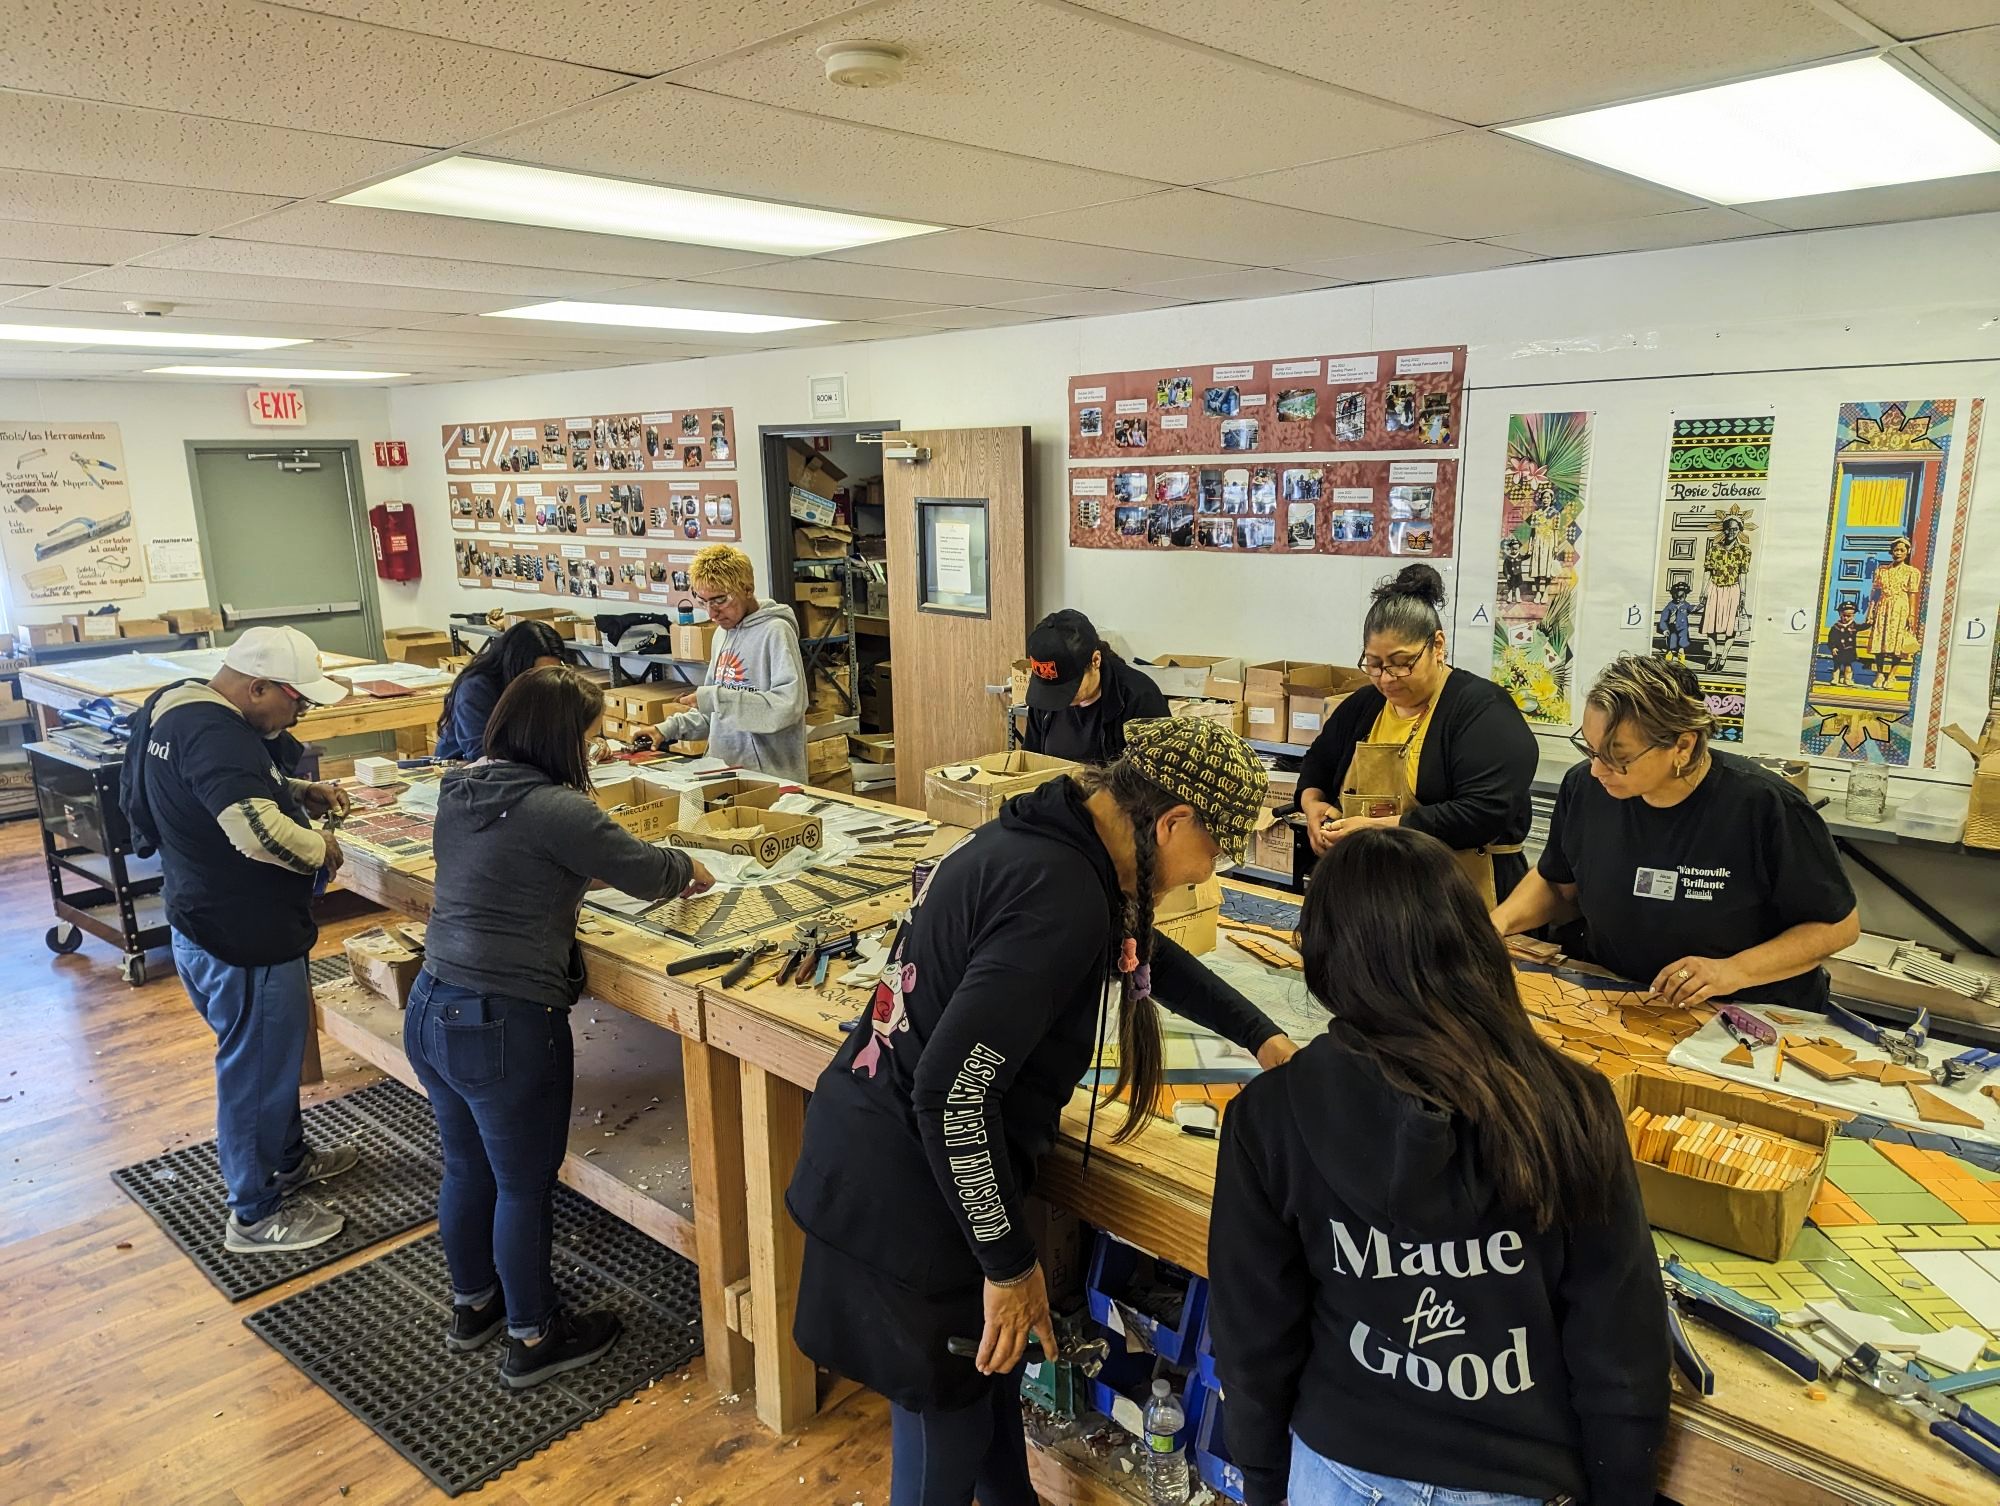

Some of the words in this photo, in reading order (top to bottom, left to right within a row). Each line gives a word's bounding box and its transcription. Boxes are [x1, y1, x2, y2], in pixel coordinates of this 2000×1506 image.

[260, 392, 296, 419] EXIT
[45, 430, 106, 440] Herramientas
[1671, 483, 1709, 499] Rosie
[1712, 482, 1761, 497] Tabasa
[36, 504, 63, 514] azulejo
[103, 546, 127, 554] azulejo
[1472, 604, 1488, 622] A
[1627, 608, 1641, 625] B
[1791, 610, 1806, 630] C
[1967, 621, 1985, 639] D
[782, 834, 801, 850] IZZE
[1677, 866, 1731, 877] Watsonville
[1681, 878, 1725, 889] Brillante
[1686, 888, 1712, 897] Rinaldi
[947, 1043, 1006, 1104] ASIAN
[944, 1106, 987, 1146] ART
[949, 1150, 1011, 1242] MUSEUM
[1403, 1287, 1466, 1349] for
[1350, 1320, 1535, 1400] Good
